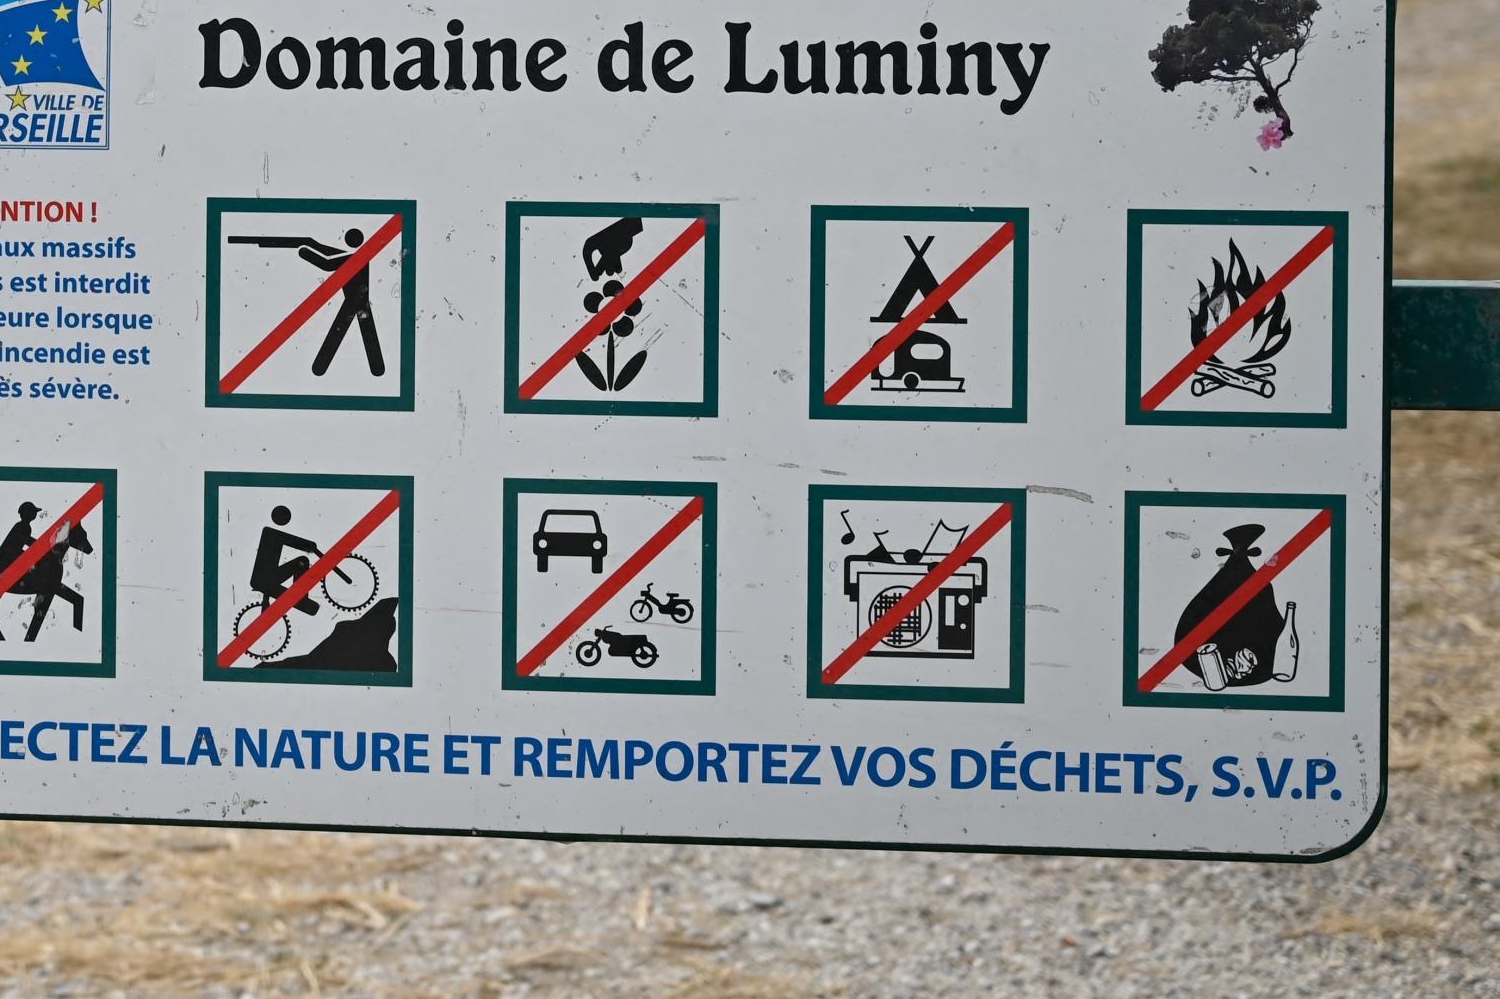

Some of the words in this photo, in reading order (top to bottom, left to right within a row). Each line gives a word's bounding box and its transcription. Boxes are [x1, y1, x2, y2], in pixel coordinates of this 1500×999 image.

[197, 17, 568, 91] Domaine
[597, 20, 695, 94] de
[724, 21, 1051, 115] Luminy
[33, 94, 76, 111] VILLE
[81, 95, 105, 111] DE
[42, 236, 136, 259] massifs
[9, 273, 47, 293] est
[54, 272, 151, 294] interdit
[56, 306, 153, 334] lorsque
[112, 345, 151, 365] est
[29, 378, 119, 401] sévère.
[159, 726, 222, 766] LA
[235, 728, 430, 774] NATURE
[443, 735, 501, 776] ET
[513, 737, 821, 786] REMPORTEZ
[830, 745, 934, 789] VOS
[949, 741, 1198, 803] DÉCHETS,
[1211, 753, 1343, 801] S.V.P.
